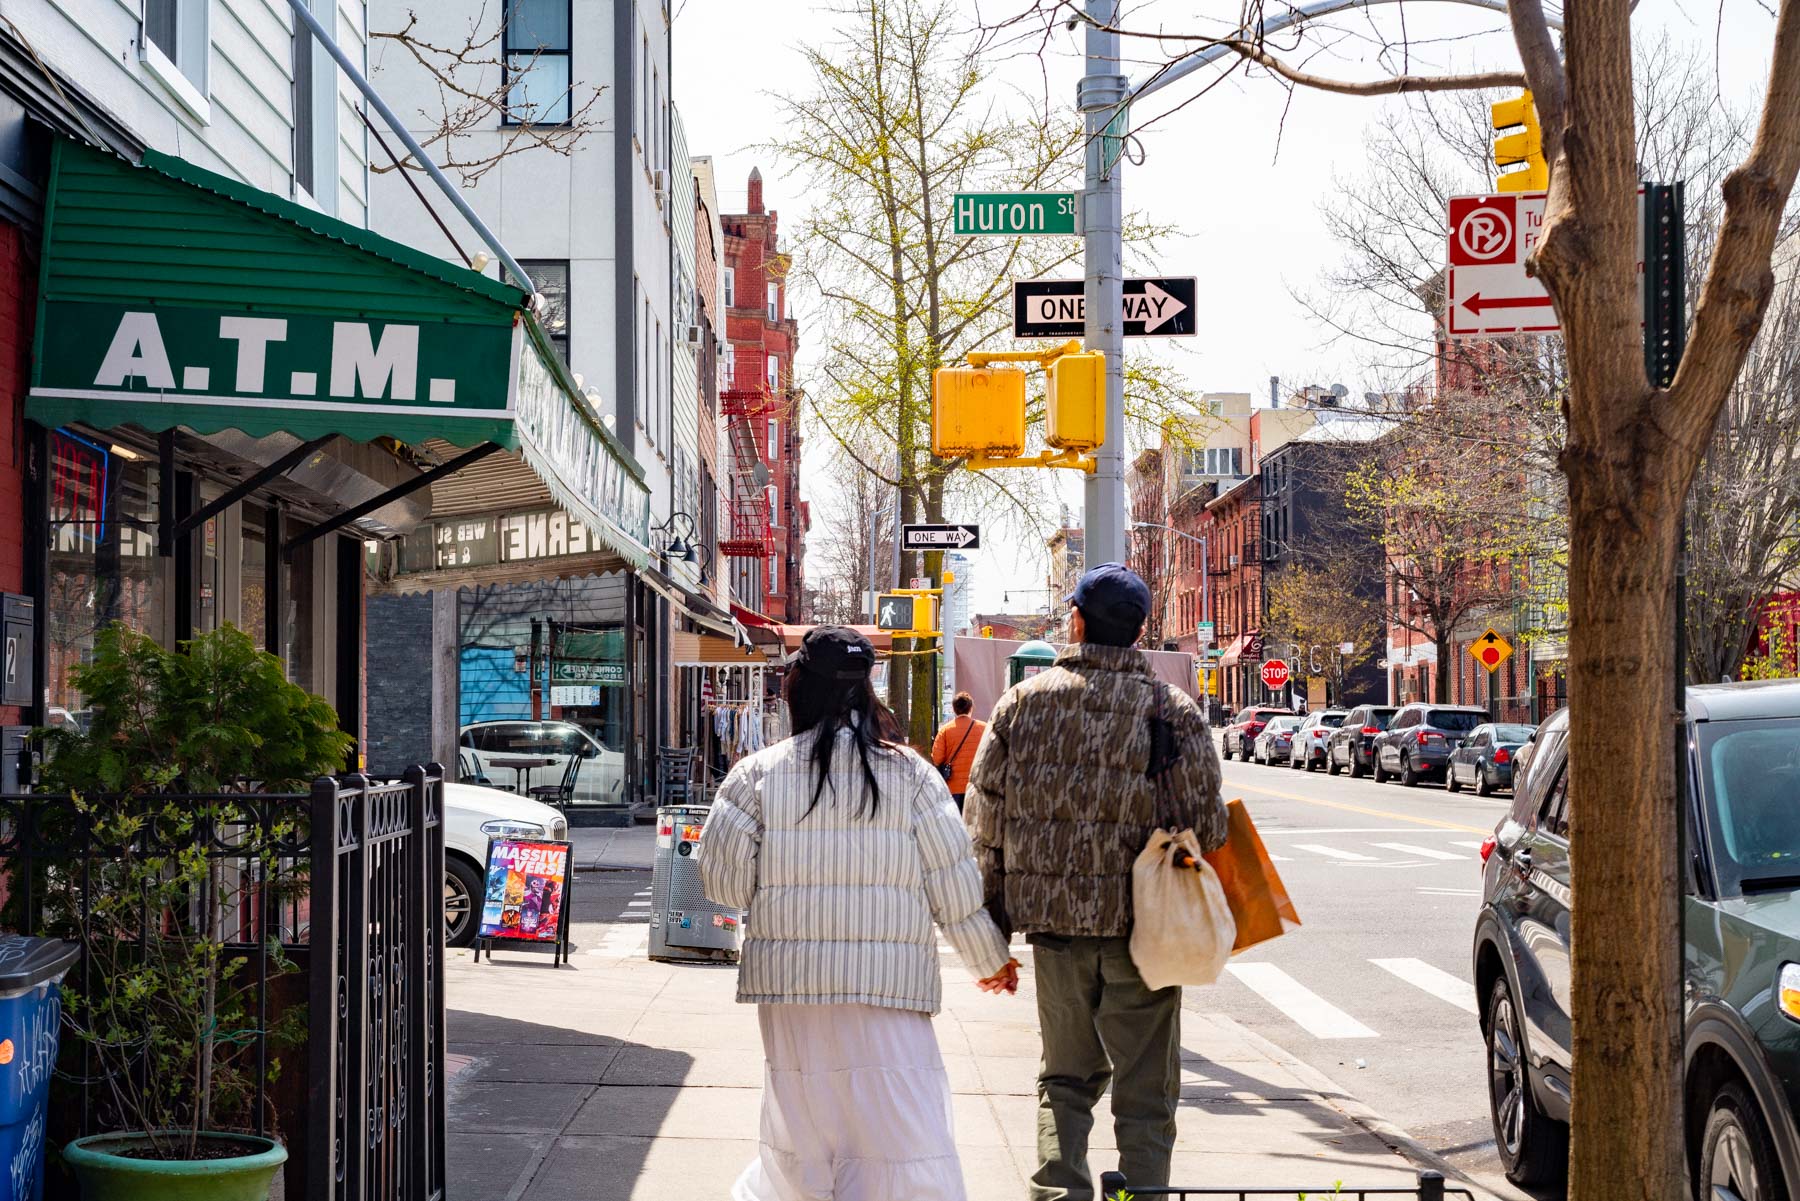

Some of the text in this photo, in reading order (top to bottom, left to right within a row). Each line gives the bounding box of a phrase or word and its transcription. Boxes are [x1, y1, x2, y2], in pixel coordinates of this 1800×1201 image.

[958, 197, 1074, 231] Huron St
[93, 311, 455, 402] A.T.M.
[914, 532, 968, 543] ONE WAY
[7, 638, 15, 683] 2
[1263, 668, 1288, 679] STOP
[491, 846, 567, 862] MASSIVE
[507, 859, 565, 876] -VERSE
